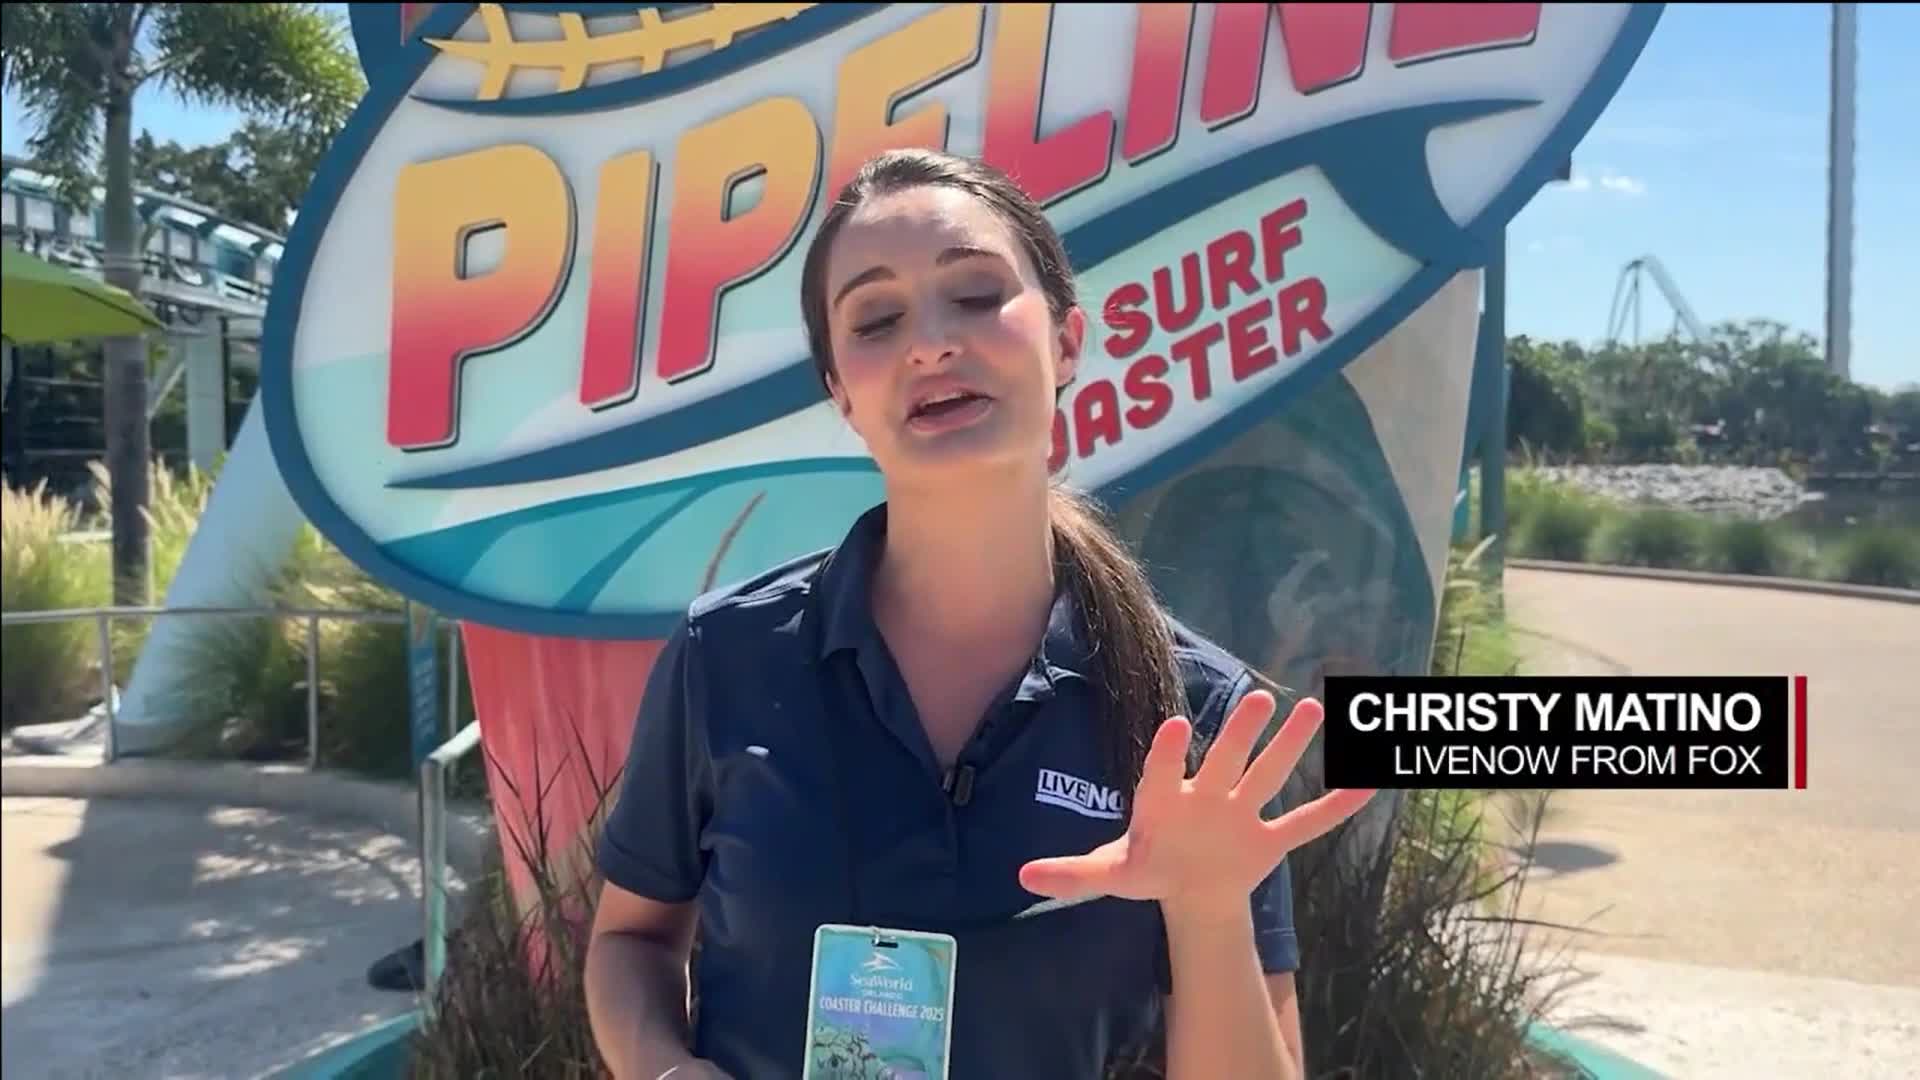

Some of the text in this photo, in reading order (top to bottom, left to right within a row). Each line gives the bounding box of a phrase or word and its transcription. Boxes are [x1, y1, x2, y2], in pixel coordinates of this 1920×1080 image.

[386, 3, 1543, 451] PIPELIN
[1103, 199, 1309, 359] SURF
[819, 995, 945, 1022] COASTER CHALLENGE 2025
[850, 974, 912, 992] SeaWorld
